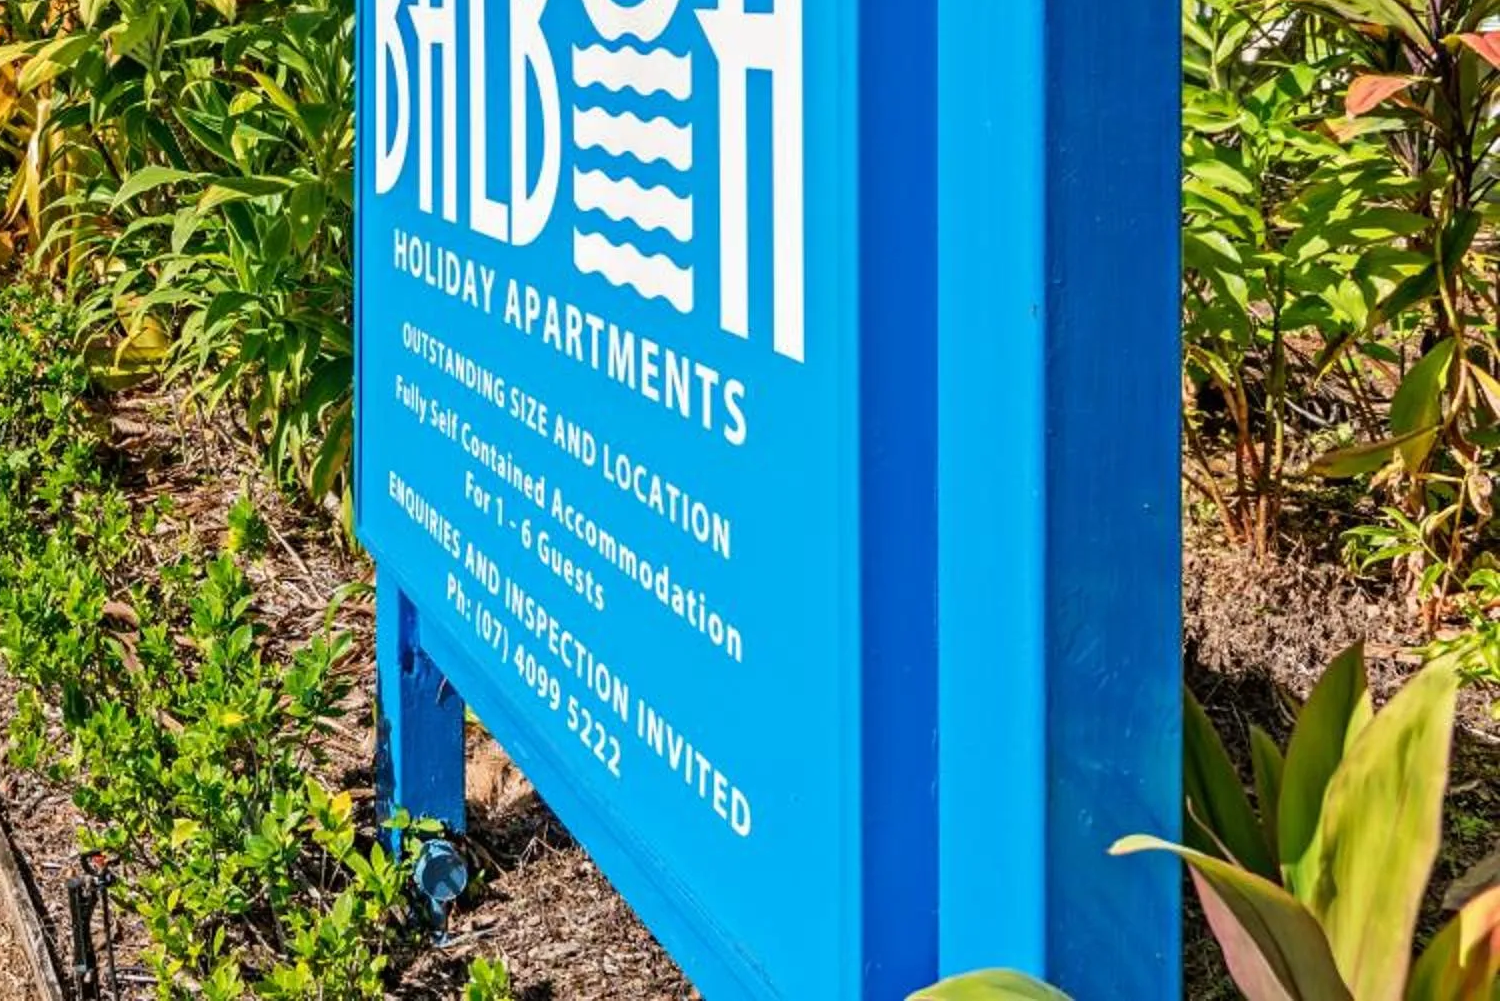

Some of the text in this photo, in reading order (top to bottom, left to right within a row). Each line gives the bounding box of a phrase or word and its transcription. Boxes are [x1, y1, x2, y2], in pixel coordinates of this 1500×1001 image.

[394, 229, 747, 446] HOLIDAY APARTMENTS
[403, 322, 730, 559] OUTSTANDING SIZE AND LOCATION
[396, 374, 742, 662] Fully Self Contained Accommodation
[465, 470, 491, 512] For
[495, 497, 503, 525] 1
[521, 519, 532, 549] 6
[537, 530, 604, 611] Guests
[389, 470, 751, 837] ENQUIRIES AND INSPECTION INVITED
[447, 572, 621, 776] Ph: (07) 4099 5222
